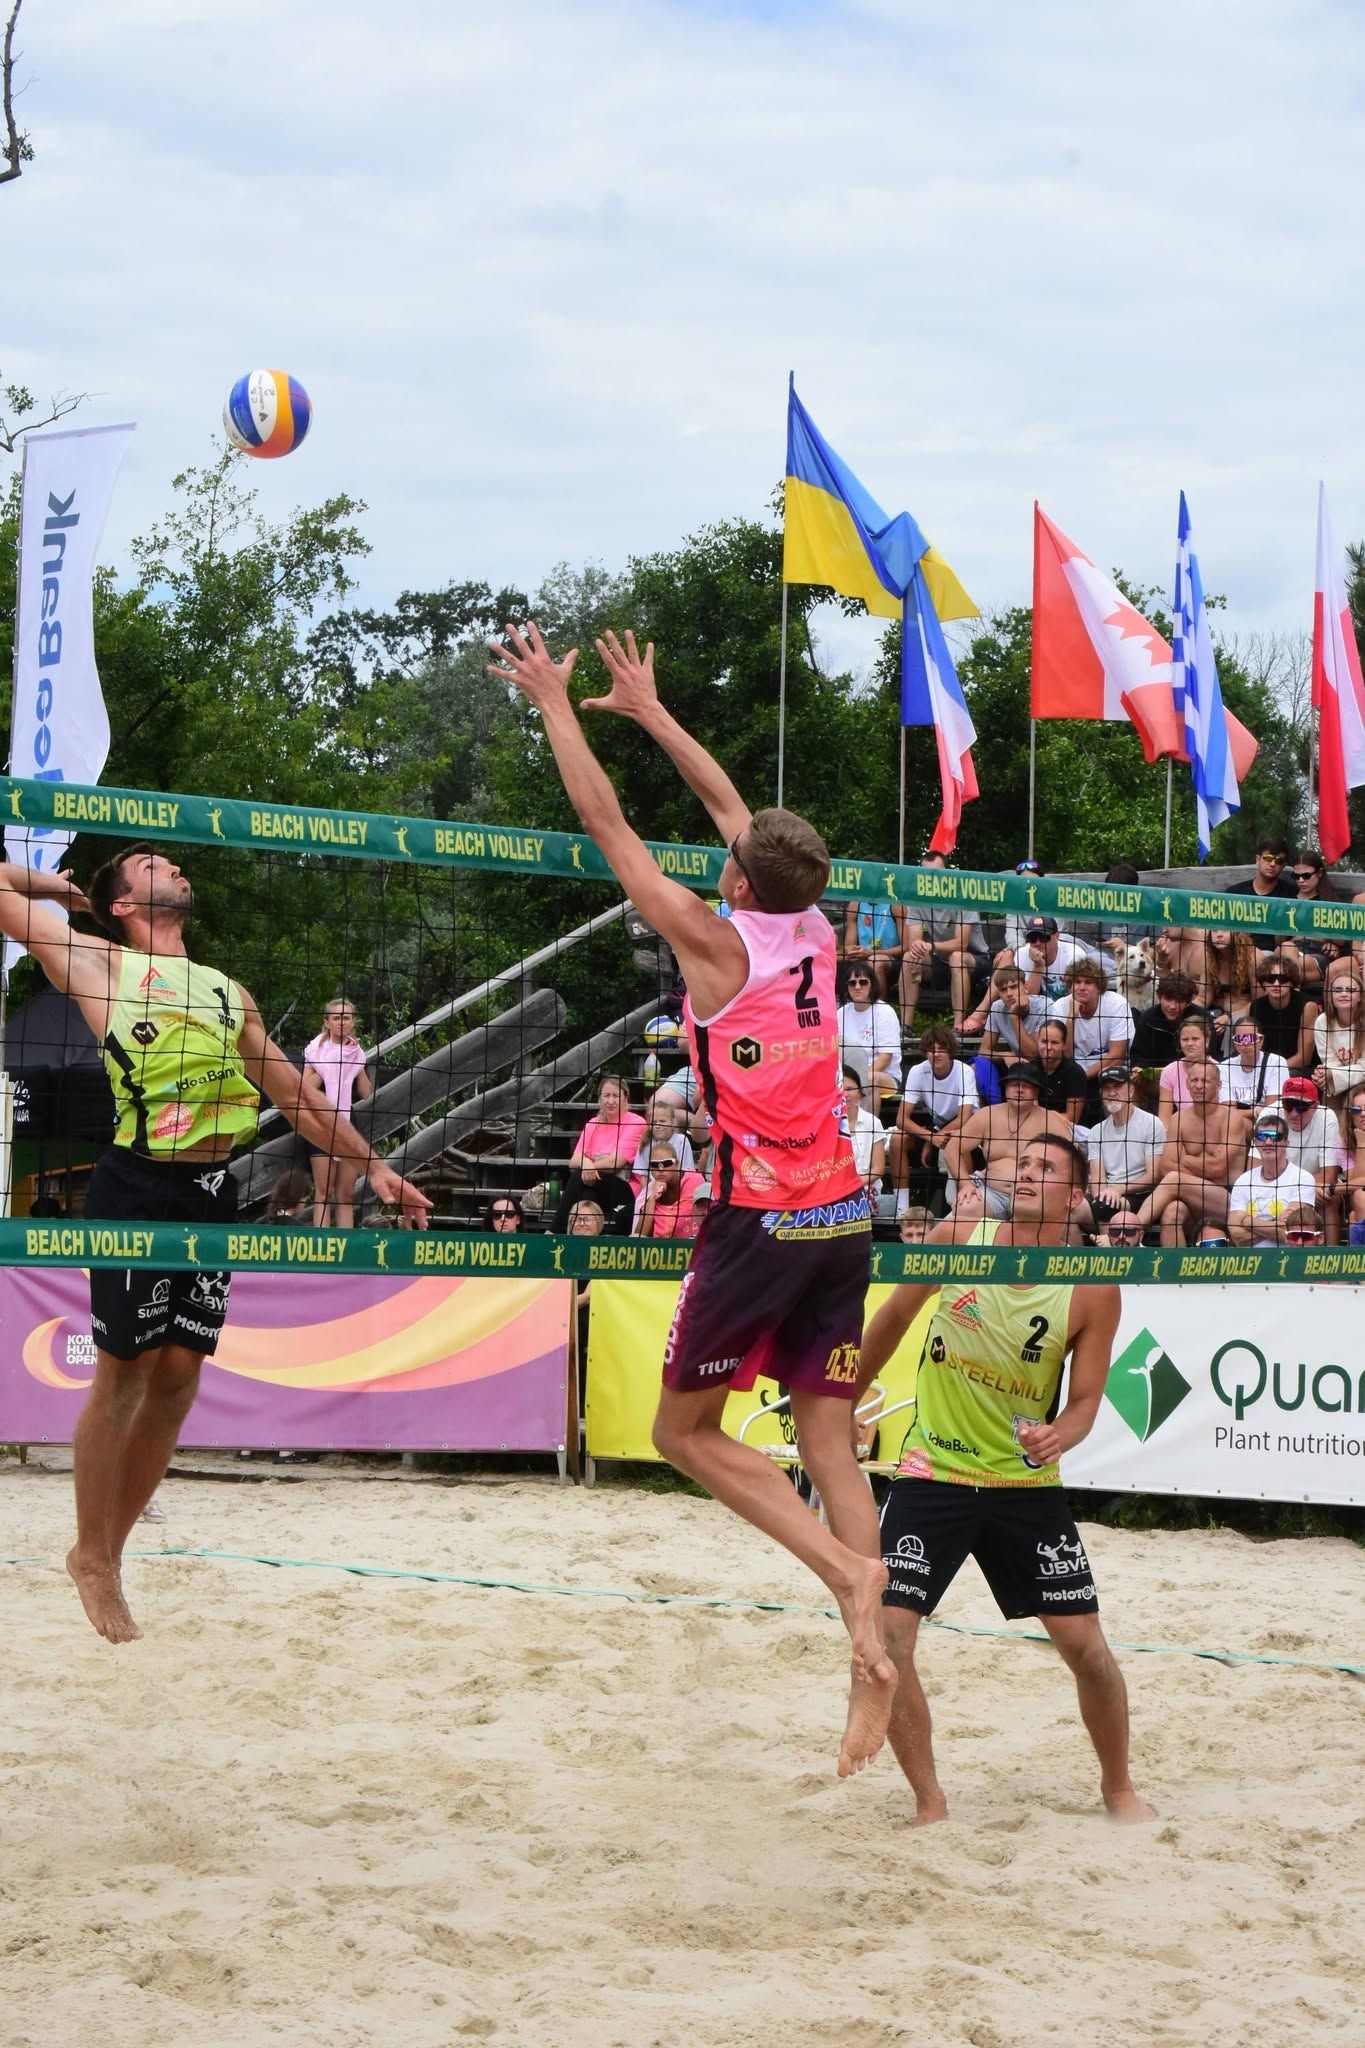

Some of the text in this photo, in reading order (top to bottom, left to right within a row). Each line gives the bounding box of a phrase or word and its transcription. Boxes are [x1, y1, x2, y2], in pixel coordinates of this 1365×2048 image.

[53, 792, 179, 828] BEACH VOLLEY
[251, 812, 368, 846] BEACH VOLLEY
[434, 829, 544, 862] BEACH VOLLEY
[656, 849, 709, 876] VOLLEY
[826, 866, 862, 890] LLEY
[916, 874, 1007, 903] BEACH VOLLEY
[1057, 886, 1142, 913] BEACH VOLLEY
[1189, 897, 1269, 924] BEACH VOLLEY
[1313, 907, 1347, 929] BEACH
[789, 956, 817, 1010] 2
[797, 1010, 821, 1029] UKR
[26, 1229, 154, 1257] BEACH VOLLEY
[227, 1235, 348, 1262] BEACH VOLLEY
[414, 1240, 526, 1267] BEACH VOLLEY
[588, 1246, 694, 1271] BEACH VOLLEY
[903, 1254, 996, 1277] BEACH VOLLEY
[1045, 1256, 1133, 1277] BEACH VOLLEY
[1179, 1256, 1262, 1277] BEACH VOLLEY
[1304, 1254, 1365, 1275] BEACH VOLL
[67, 1334, 93, 1345] KOR
[1023, 1315, 1049, 1351] 2
[1020, 1349, 1041, 1364] UKR
[947, 1352, 1006, 1397] STEEL
[1215, 1426, 1270, 1452] Plant
[882, 1557, 931, 1576] SUNRISE
[1040, 1556, 1088, 1576] UBVF
